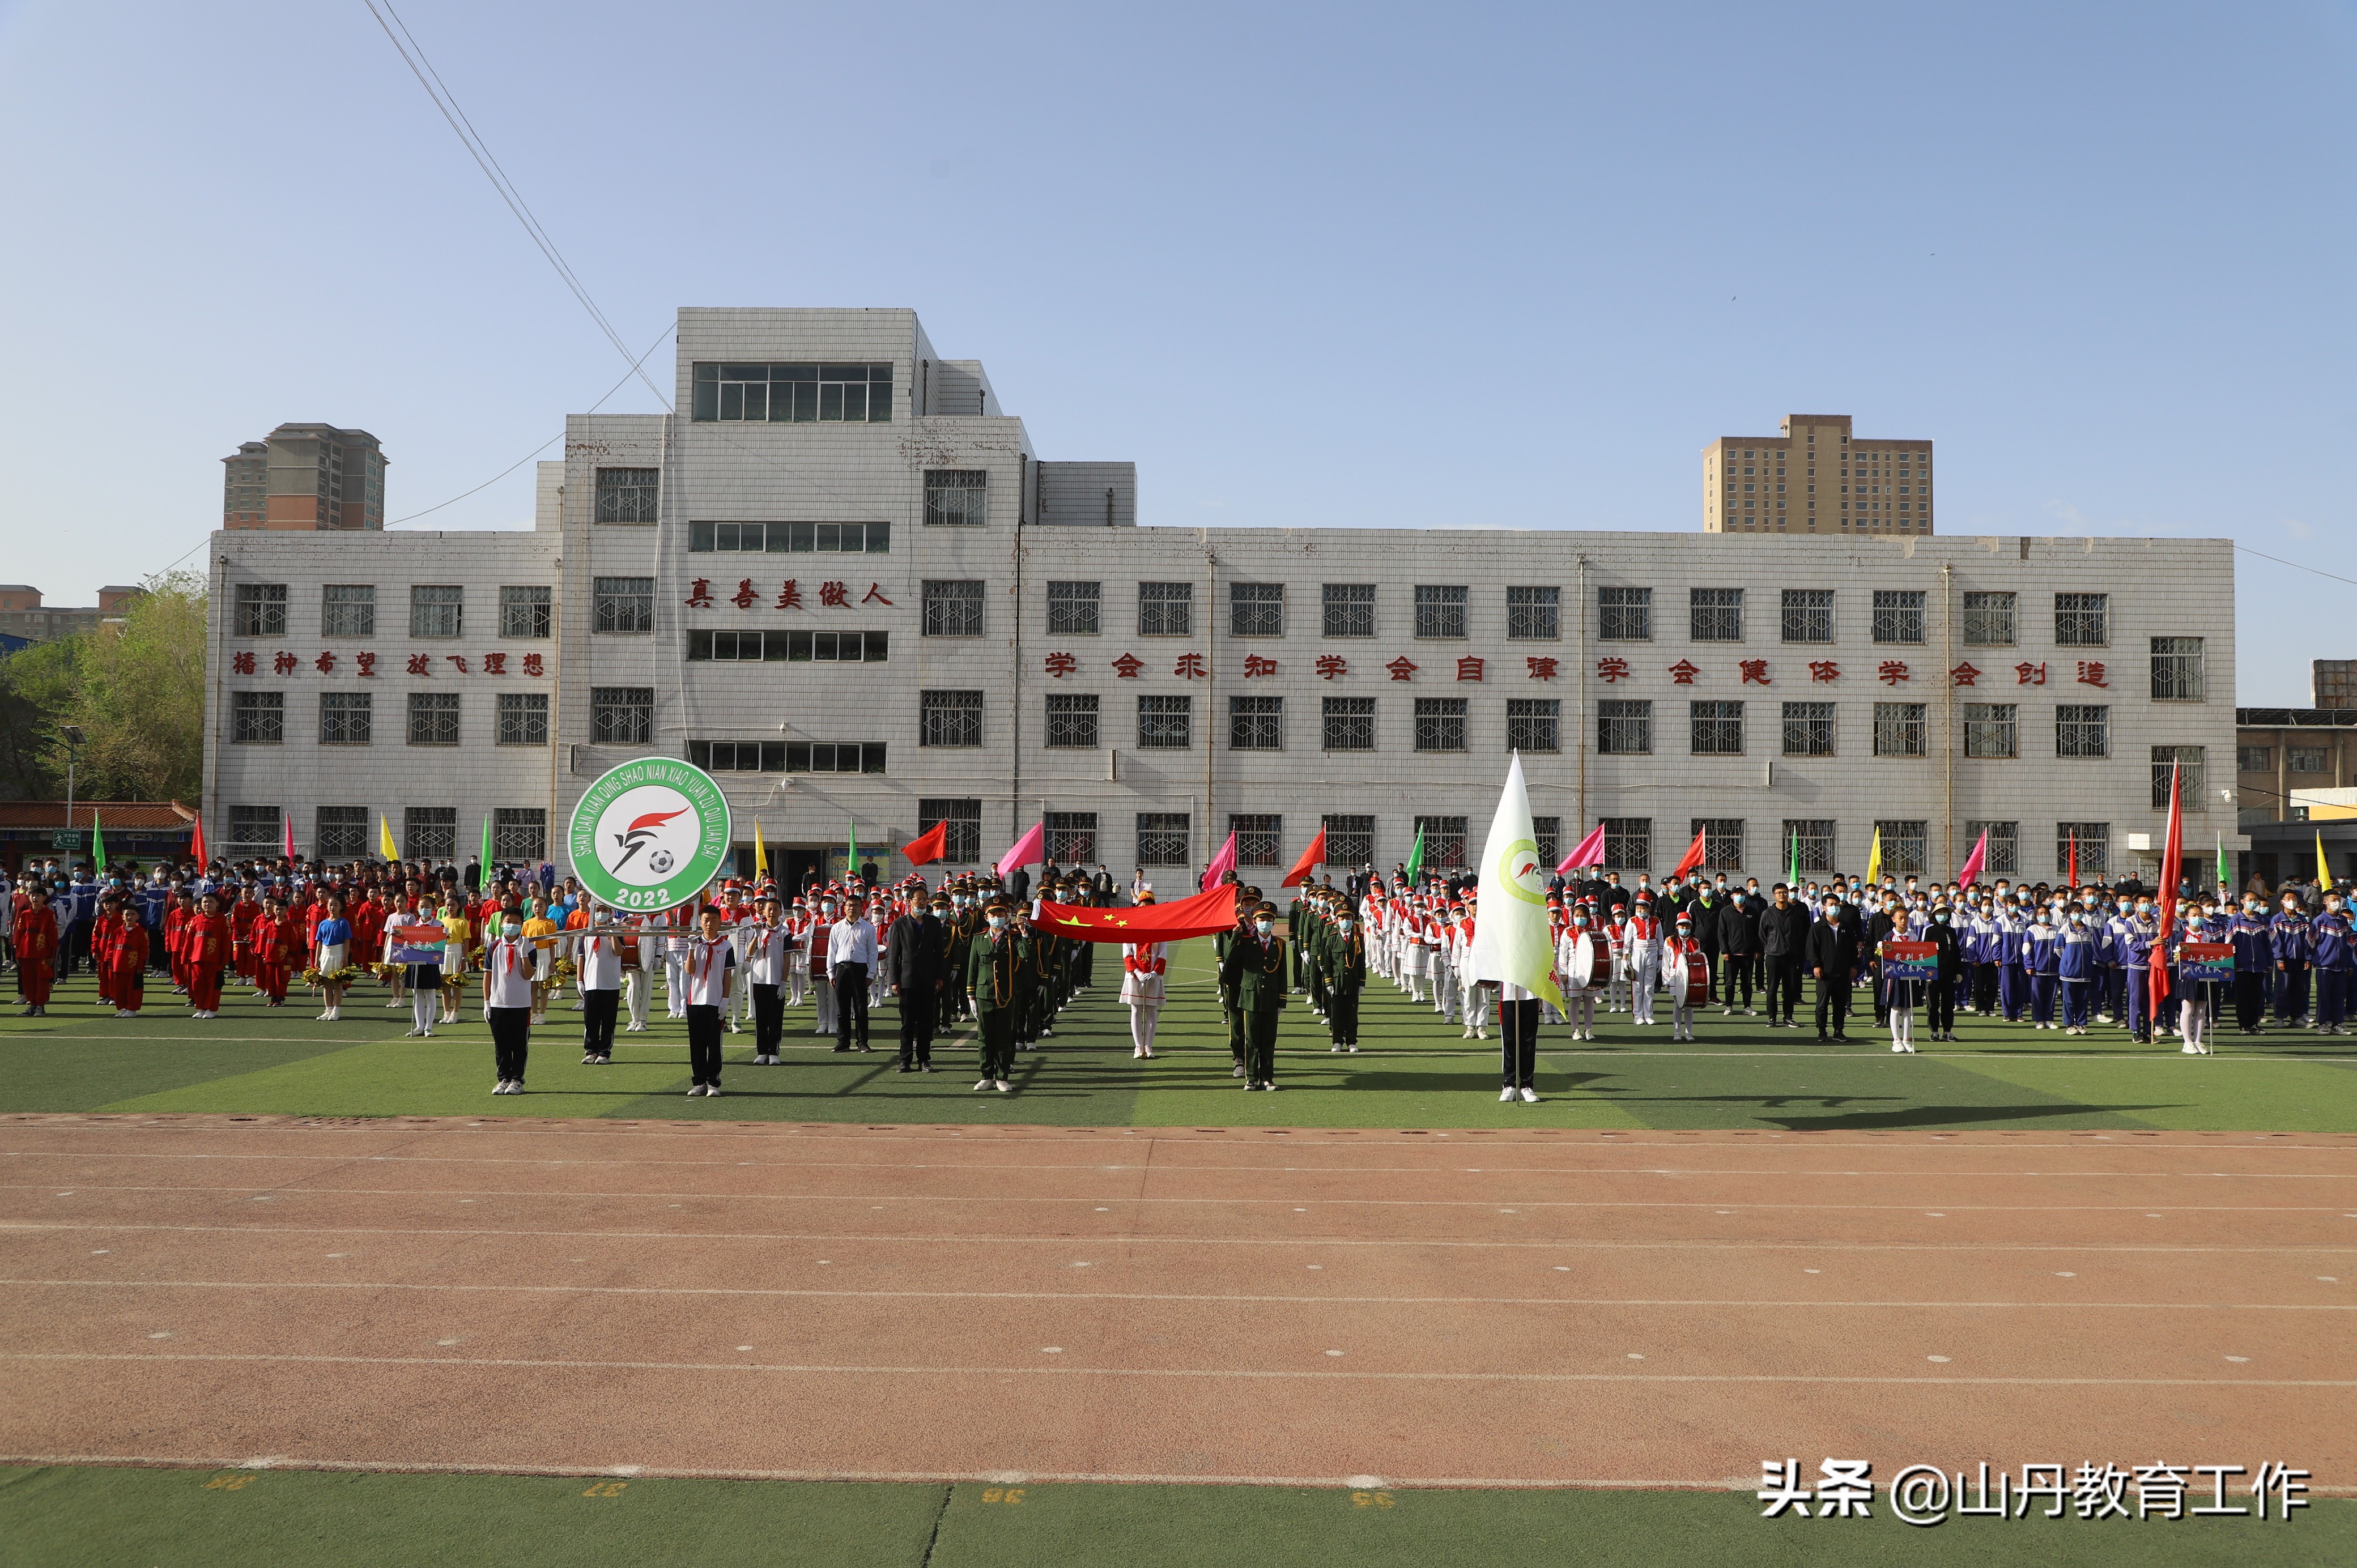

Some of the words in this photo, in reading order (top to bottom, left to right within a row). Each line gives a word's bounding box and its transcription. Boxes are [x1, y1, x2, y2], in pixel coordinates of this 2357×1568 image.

[684, 578, 894, 609] 真善美做人
[619, 766, 644, 786] SHAO
[646, 765, 667, 781] NIAN
[666, 766, 690, 786] XIAO
[598, 777, 623, 799] QING
[685, 776, 710, 800] YUAN
[582, 793, 606, 816] XIAN
[698, 794, 718, 809] ZU
[575, 814, 595, 832] DAN
[703, 807, 723, 823] QIU
[705, 824, 723, 843] LIAN
[574, 834, 592, 857] SHAN
[700, 844, 720, 860] SAI
[614, 888, 671, 907] 2022
[402, 940, 436, 951] 表演队
[1894, 952, 1925, 963] 裁判员
[2188, 954, 2226, 964] 山丹二中
[1897, 964, 1925, 973] 代表队
[2194, 965, 2222, 974] 代表队
